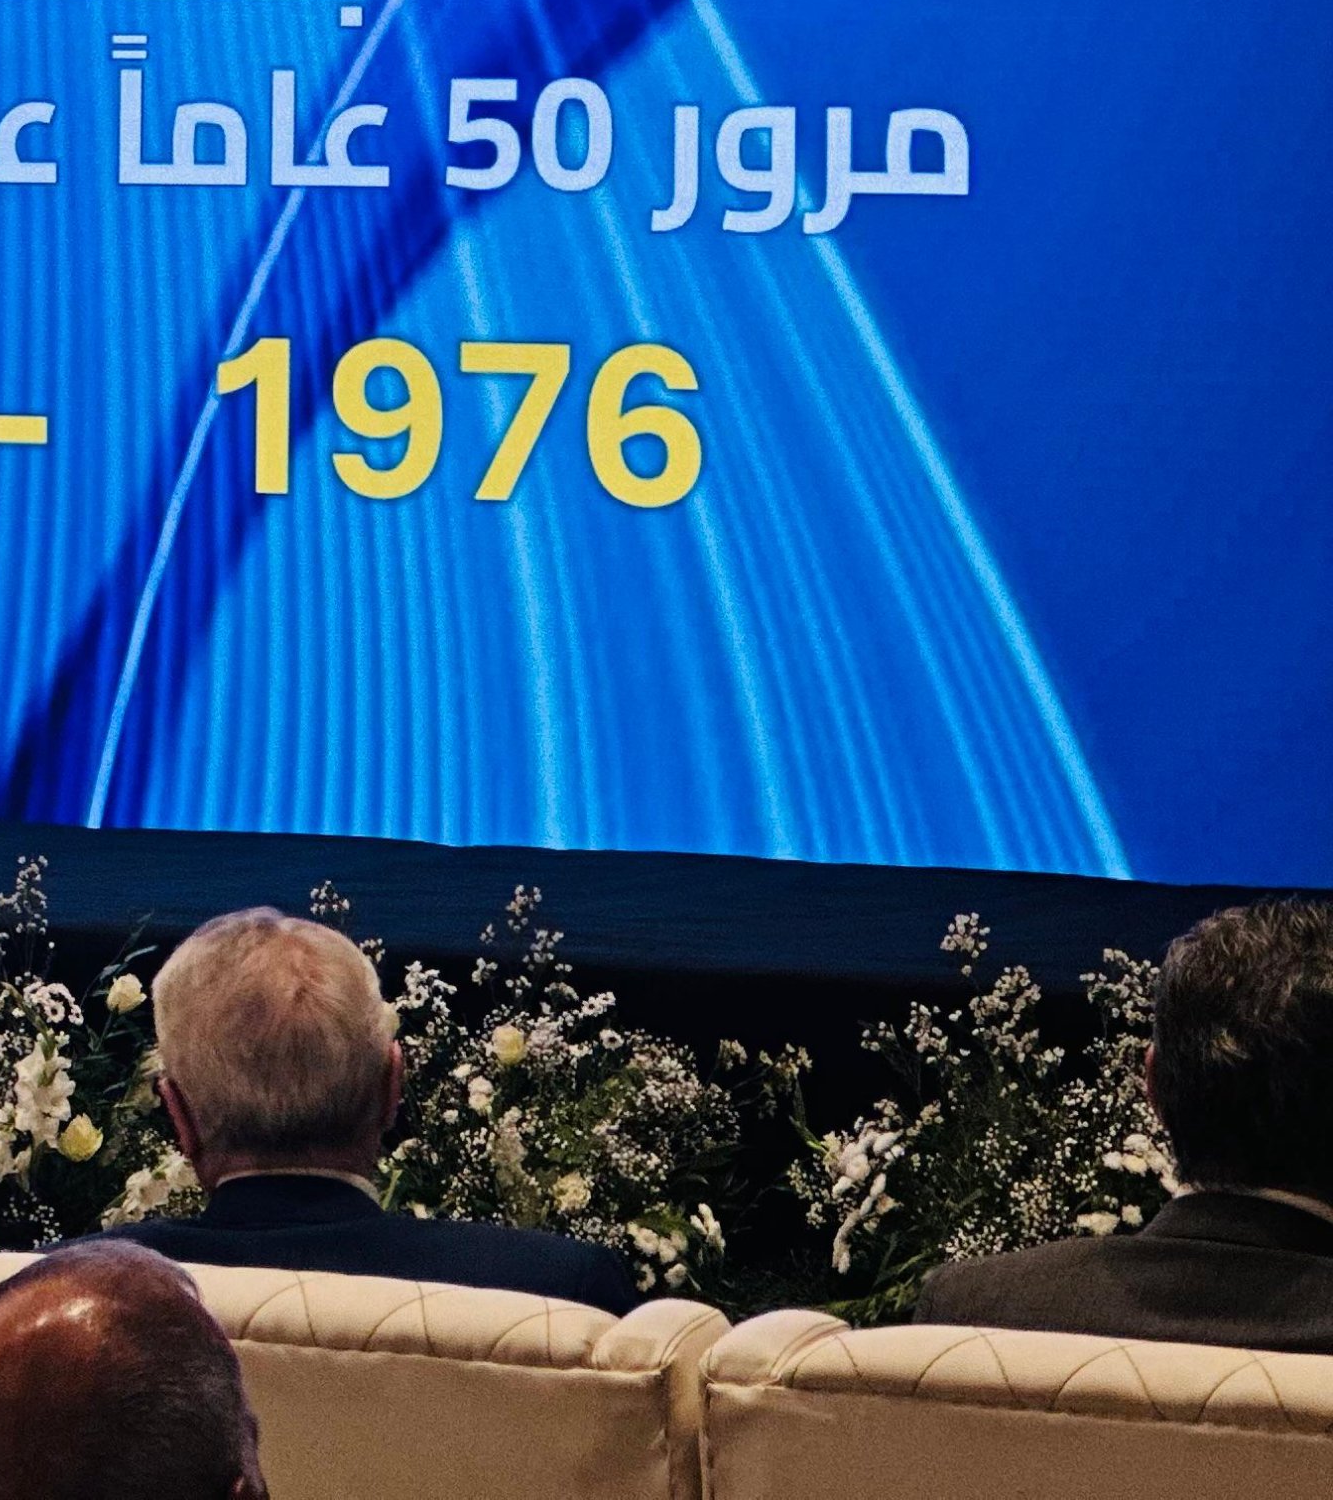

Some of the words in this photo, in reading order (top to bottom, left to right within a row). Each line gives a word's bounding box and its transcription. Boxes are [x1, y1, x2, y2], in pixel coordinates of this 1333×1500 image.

[111, 35, 390, 188] عاماً
[445, 77, 613, 192] 50
[650, 106, 970, 234] مرور
[215, 336, 704, 510] 1976
